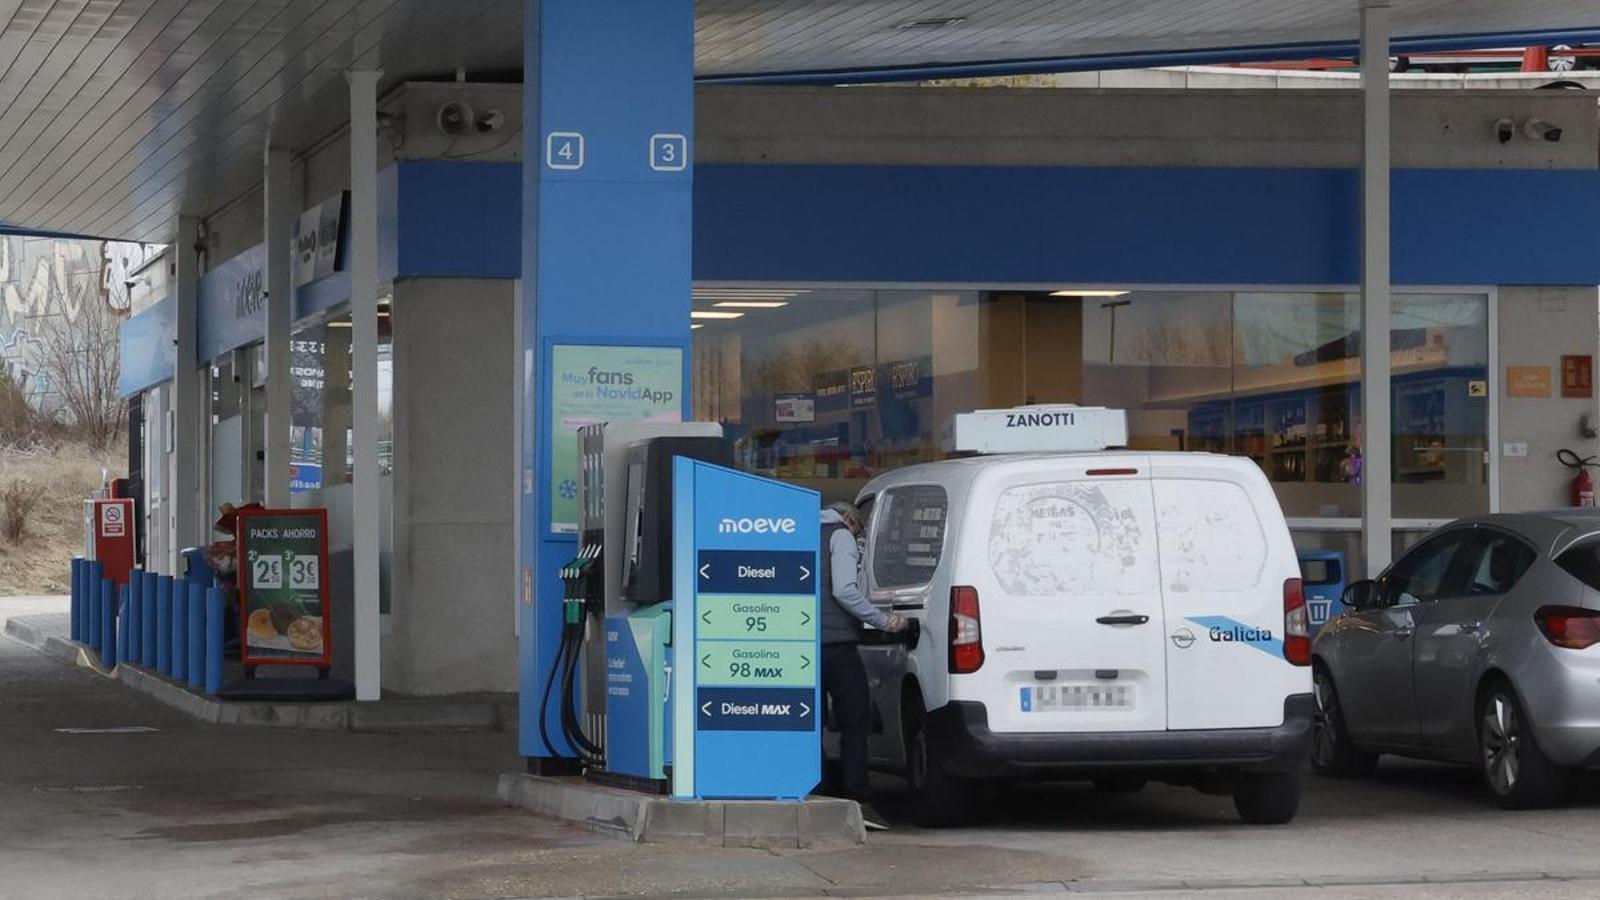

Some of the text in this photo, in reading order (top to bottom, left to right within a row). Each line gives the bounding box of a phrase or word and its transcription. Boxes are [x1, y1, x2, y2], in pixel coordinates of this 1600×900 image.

[558, 142, 573, 160] 4
[662, 143, 675, 161] 3
[587, 366, 634, 385] fans
[1006, 413, 1074, 427] ZANOTTI
[719, 517, 797, 533] moeve
[250, 528, 316, 538] PACKS AHORRO
[738, 566, 776, 578] Diesel
[732, 603, 781, 613] Gasolina
[746, 617, 767, 632] 95
[1209, 626, 1272, 641] Galicia
[732, 649, 780, 659] Gasolina
[729, 662, 783, 678] 98 MAX
[721, 703, 791, 715] Diesel MAX
